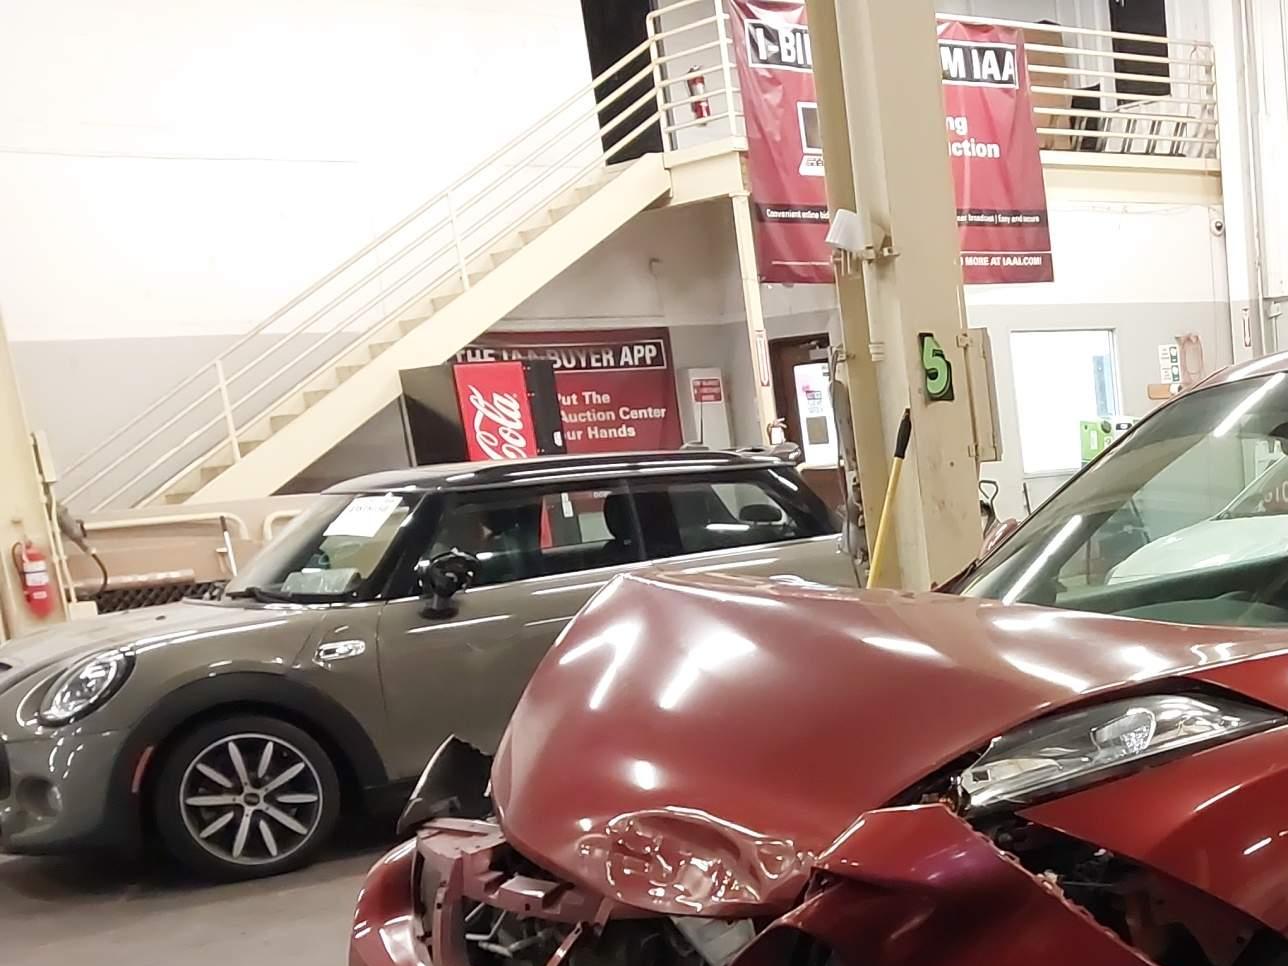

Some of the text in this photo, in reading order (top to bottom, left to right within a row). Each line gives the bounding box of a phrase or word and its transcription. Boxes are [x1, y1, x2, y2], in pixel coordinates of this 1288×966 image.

[940, 46, 966, 79] M
[971, 48, 1015, 81] IAA
[945, 116, 968, 136] ng
[948, 137, 1001, 158] ction
[964, 256, 990, 266] MORE
[990, 256, 1001, 266] AT
[548, 346, 615, 369] BUYER
[619, 344, 658, 367] APP
[922, 334, 950, 398] 5
[582, 391, 611, 405] The
[618, 406, 667, 420] Center
[564, 424, 636, 441] ur Hands
